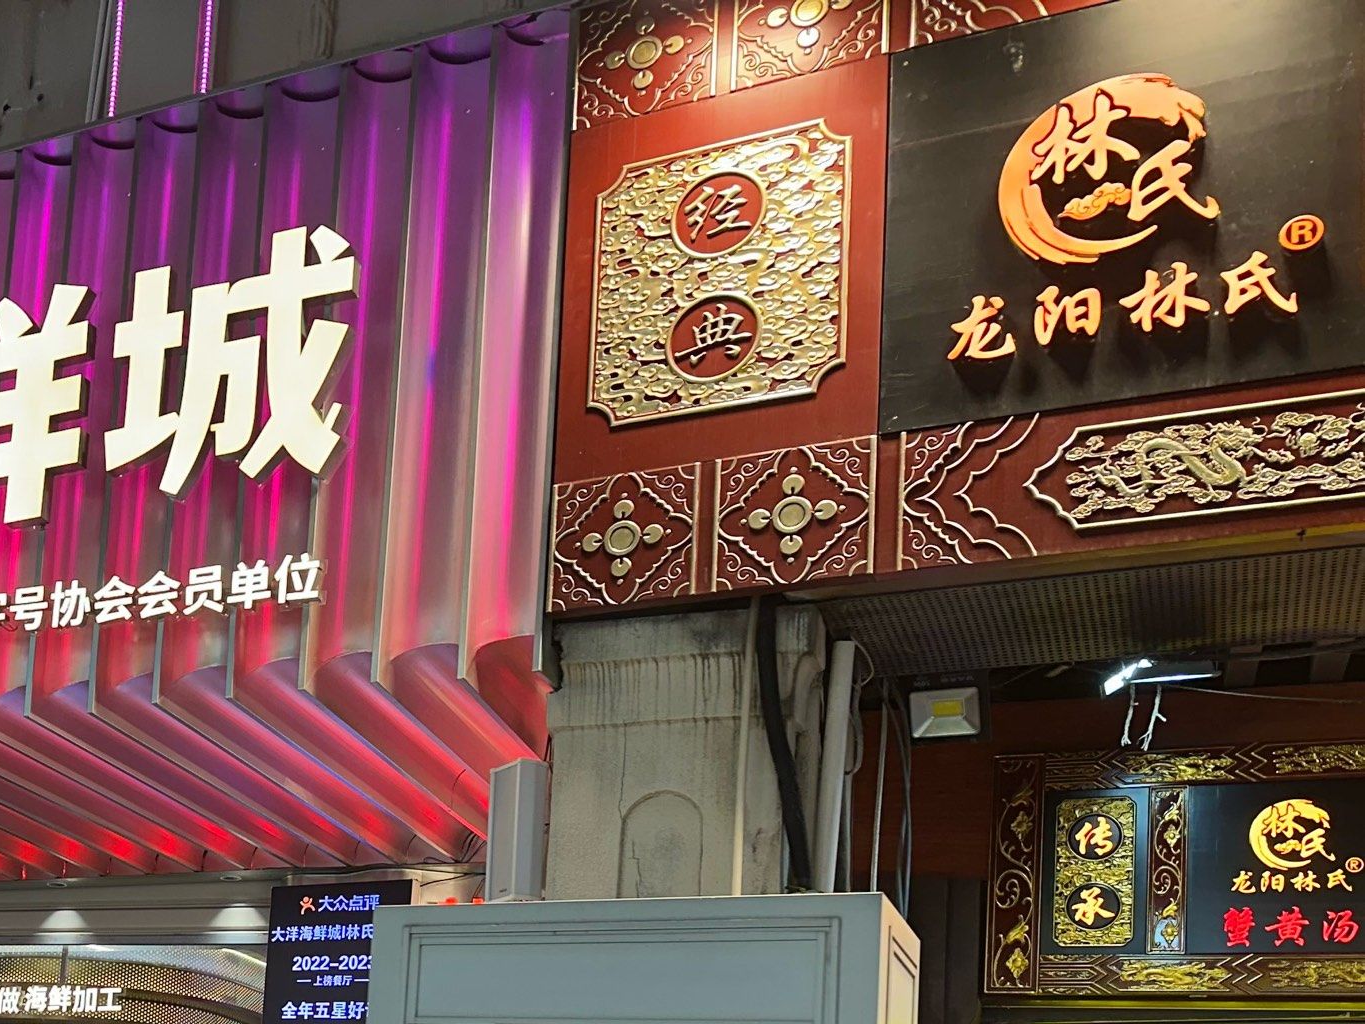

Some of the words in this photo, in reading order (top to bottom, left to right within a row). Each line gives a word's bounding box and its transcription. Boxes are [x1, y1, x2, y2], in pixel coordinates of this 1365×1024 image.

[946, 250, 1299, 360] 龙阳林氏
[1231, 869, 1353, 893] 龙阳林氏
[318, 894, 380, 912] 大众点评
[1223, 906, 1359, 947] 蟹黄汤
[24, 985, 123, 1012] 海鲜加工
